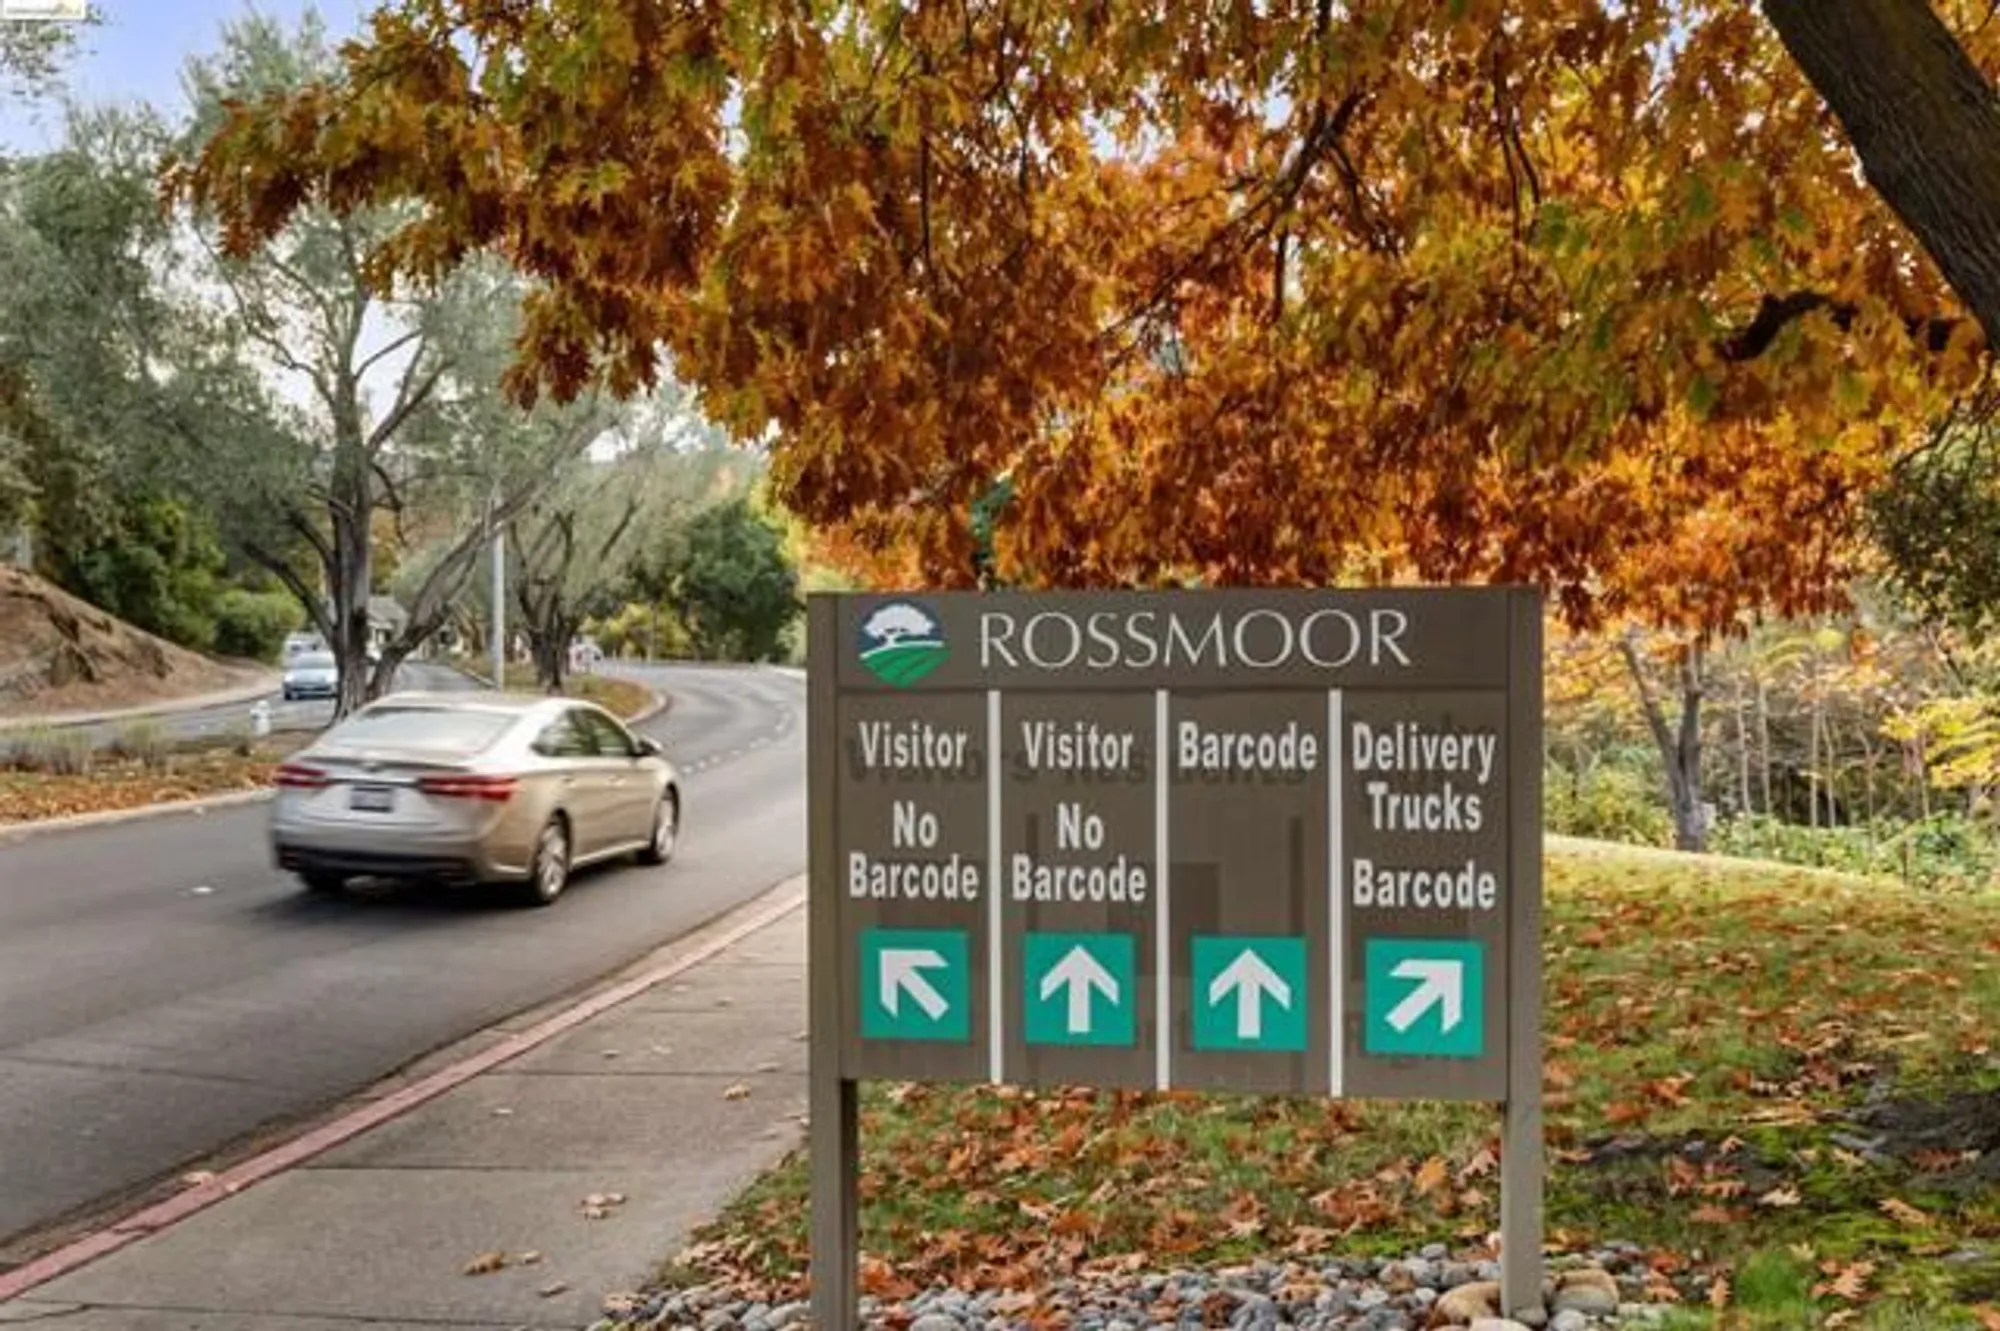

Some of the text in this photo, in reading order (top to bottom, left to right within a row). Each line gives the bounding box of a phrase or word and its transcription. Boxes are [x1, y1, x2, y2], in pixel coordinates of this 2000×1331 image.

[980, 608, 1411, 669] ROSSMOOR
[858, 720, 968, 769] Visitor
[1021, 720, 1134, 770] Visitor
[1178, 720, 1318, 771] Barcode
[1352, 721, 1496, 784] Delivery
[892, 799, 939, 849] No
[1057, 801, 1105, 851] No
[1366, 781, 1483, 832] Trucks
[848, 851, 980, 901] Barcode
[1011, 852, 1147, 903] Barcode
[1352, 858, 1497, 911] Barcode
